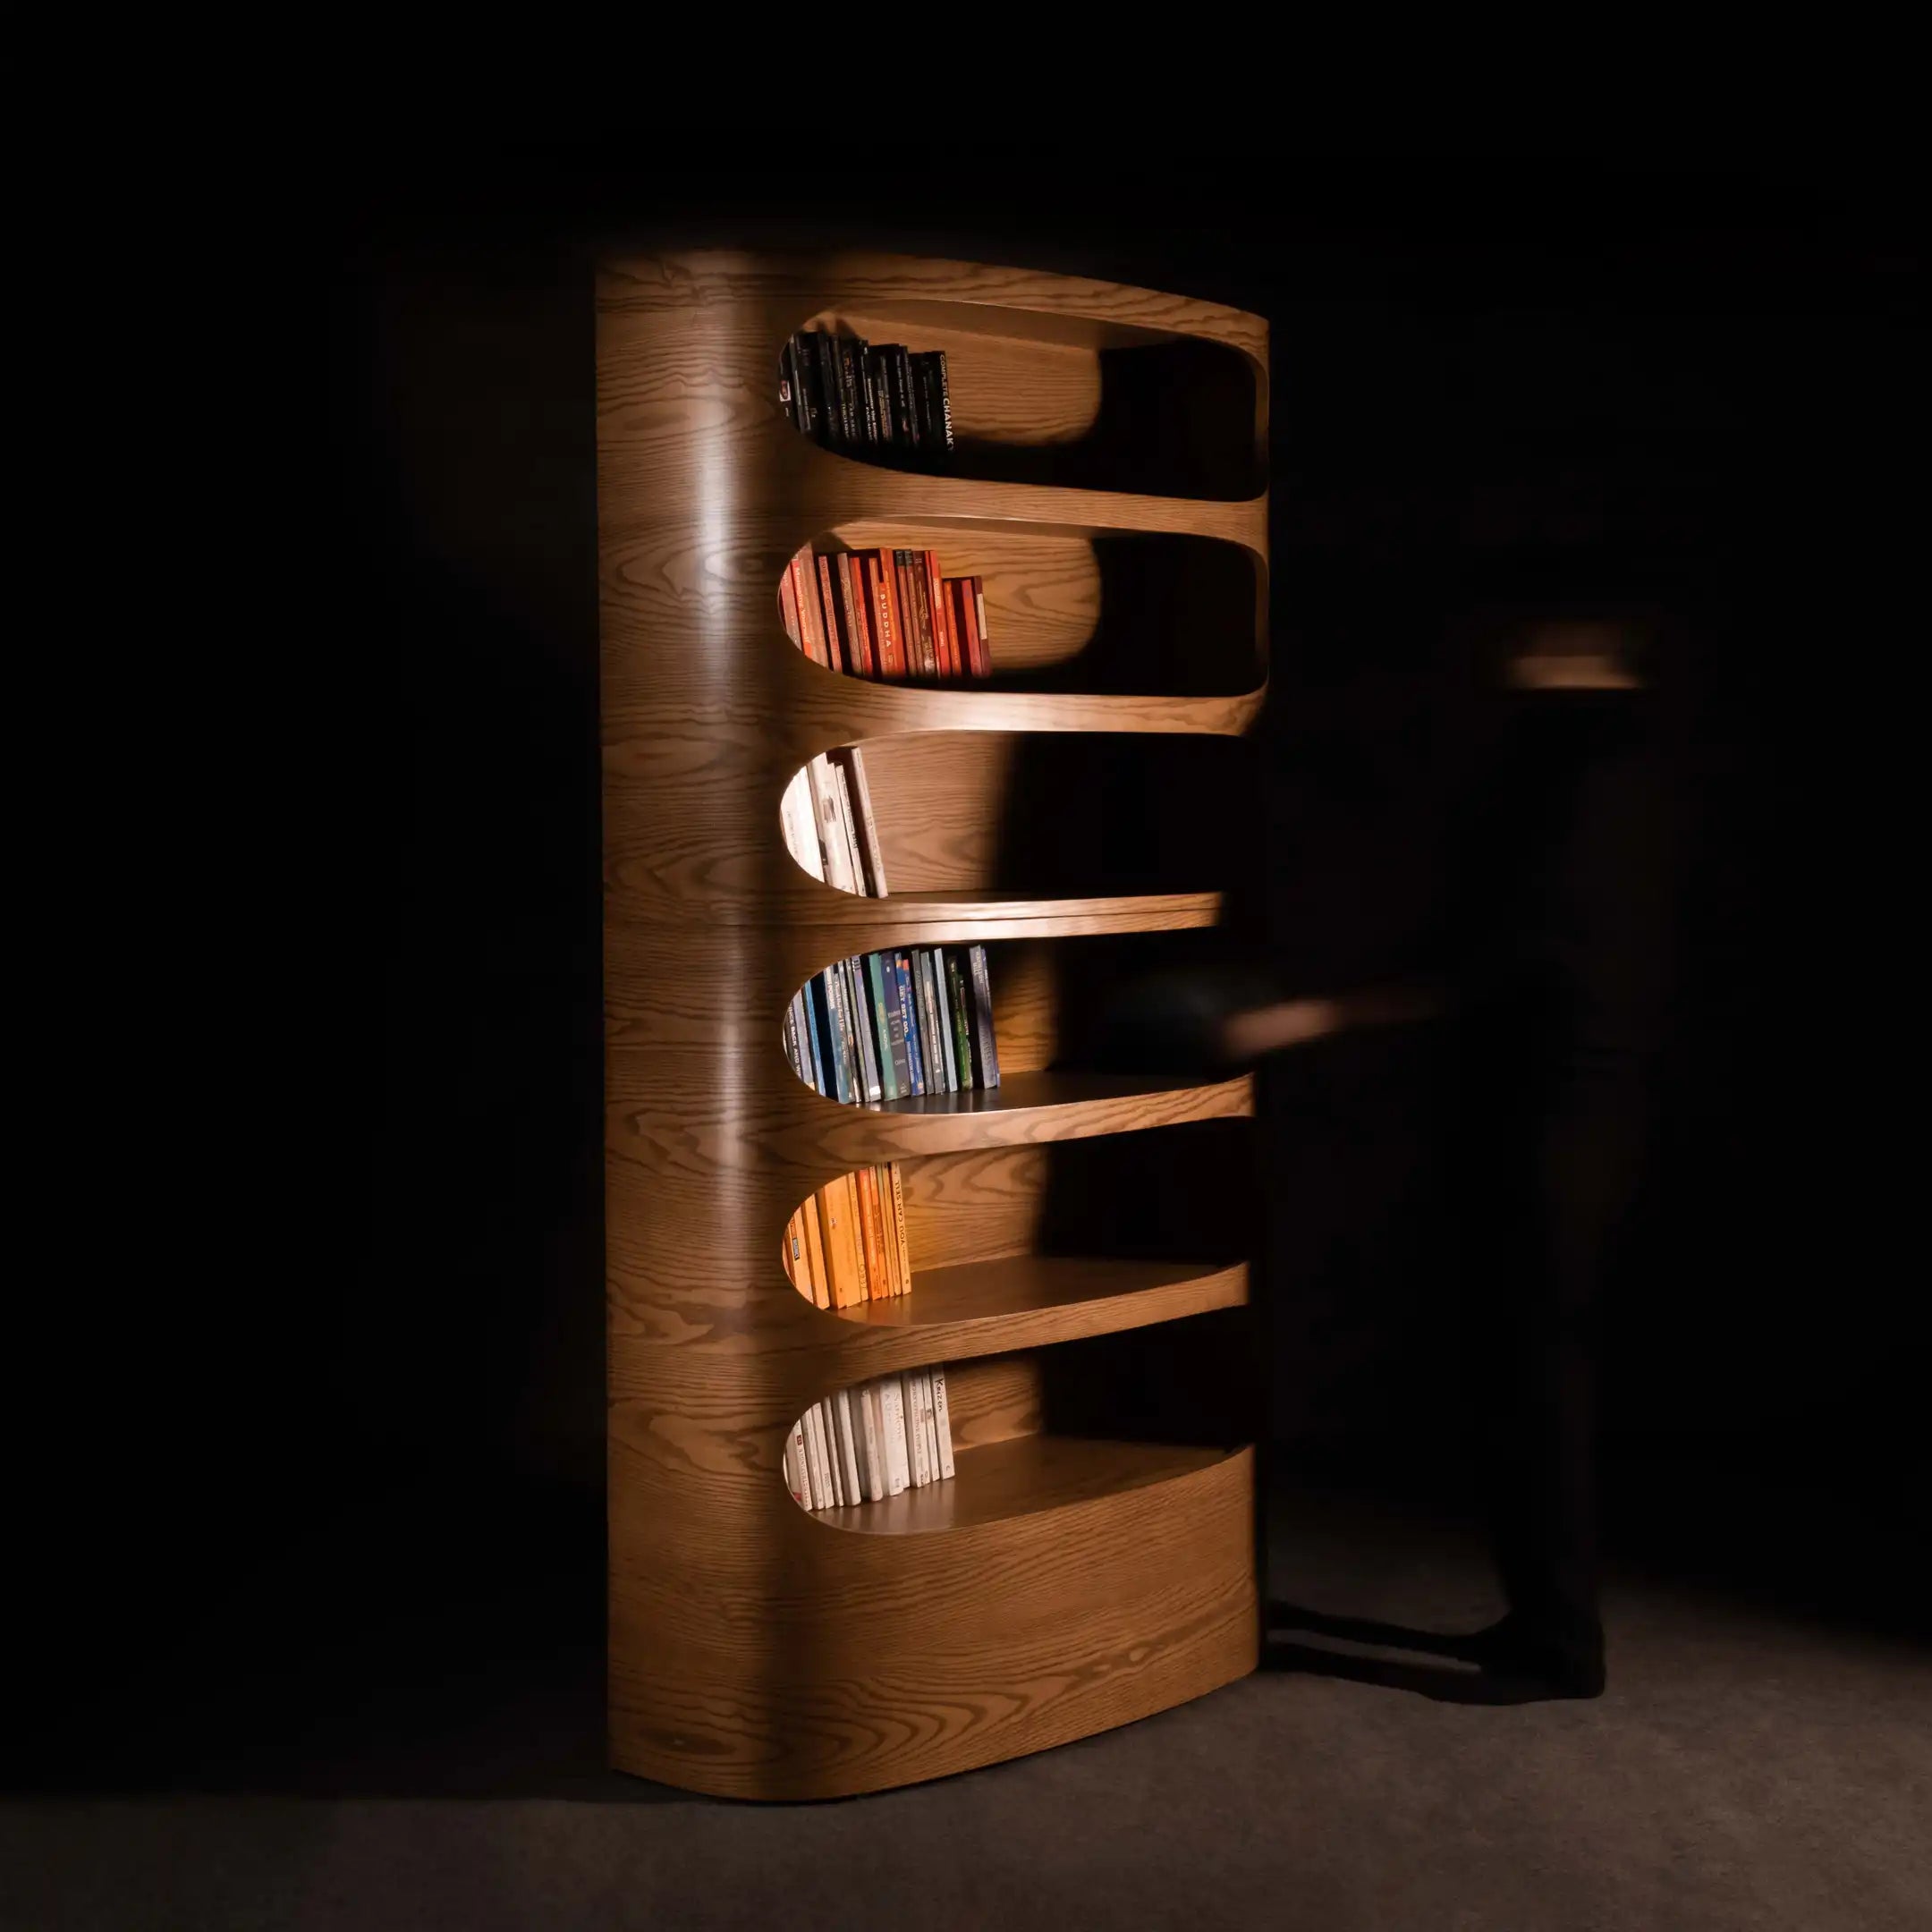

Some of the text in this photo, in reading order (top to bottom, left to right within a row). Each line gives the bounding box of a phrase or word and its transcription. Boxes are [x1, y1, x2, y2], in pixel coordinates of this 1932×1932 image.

[939, 354, 948, 396] COMPLETE
[880, 593, 892, 648] BUDDHA
[935, 1378, 945, 1411] Kaizen
